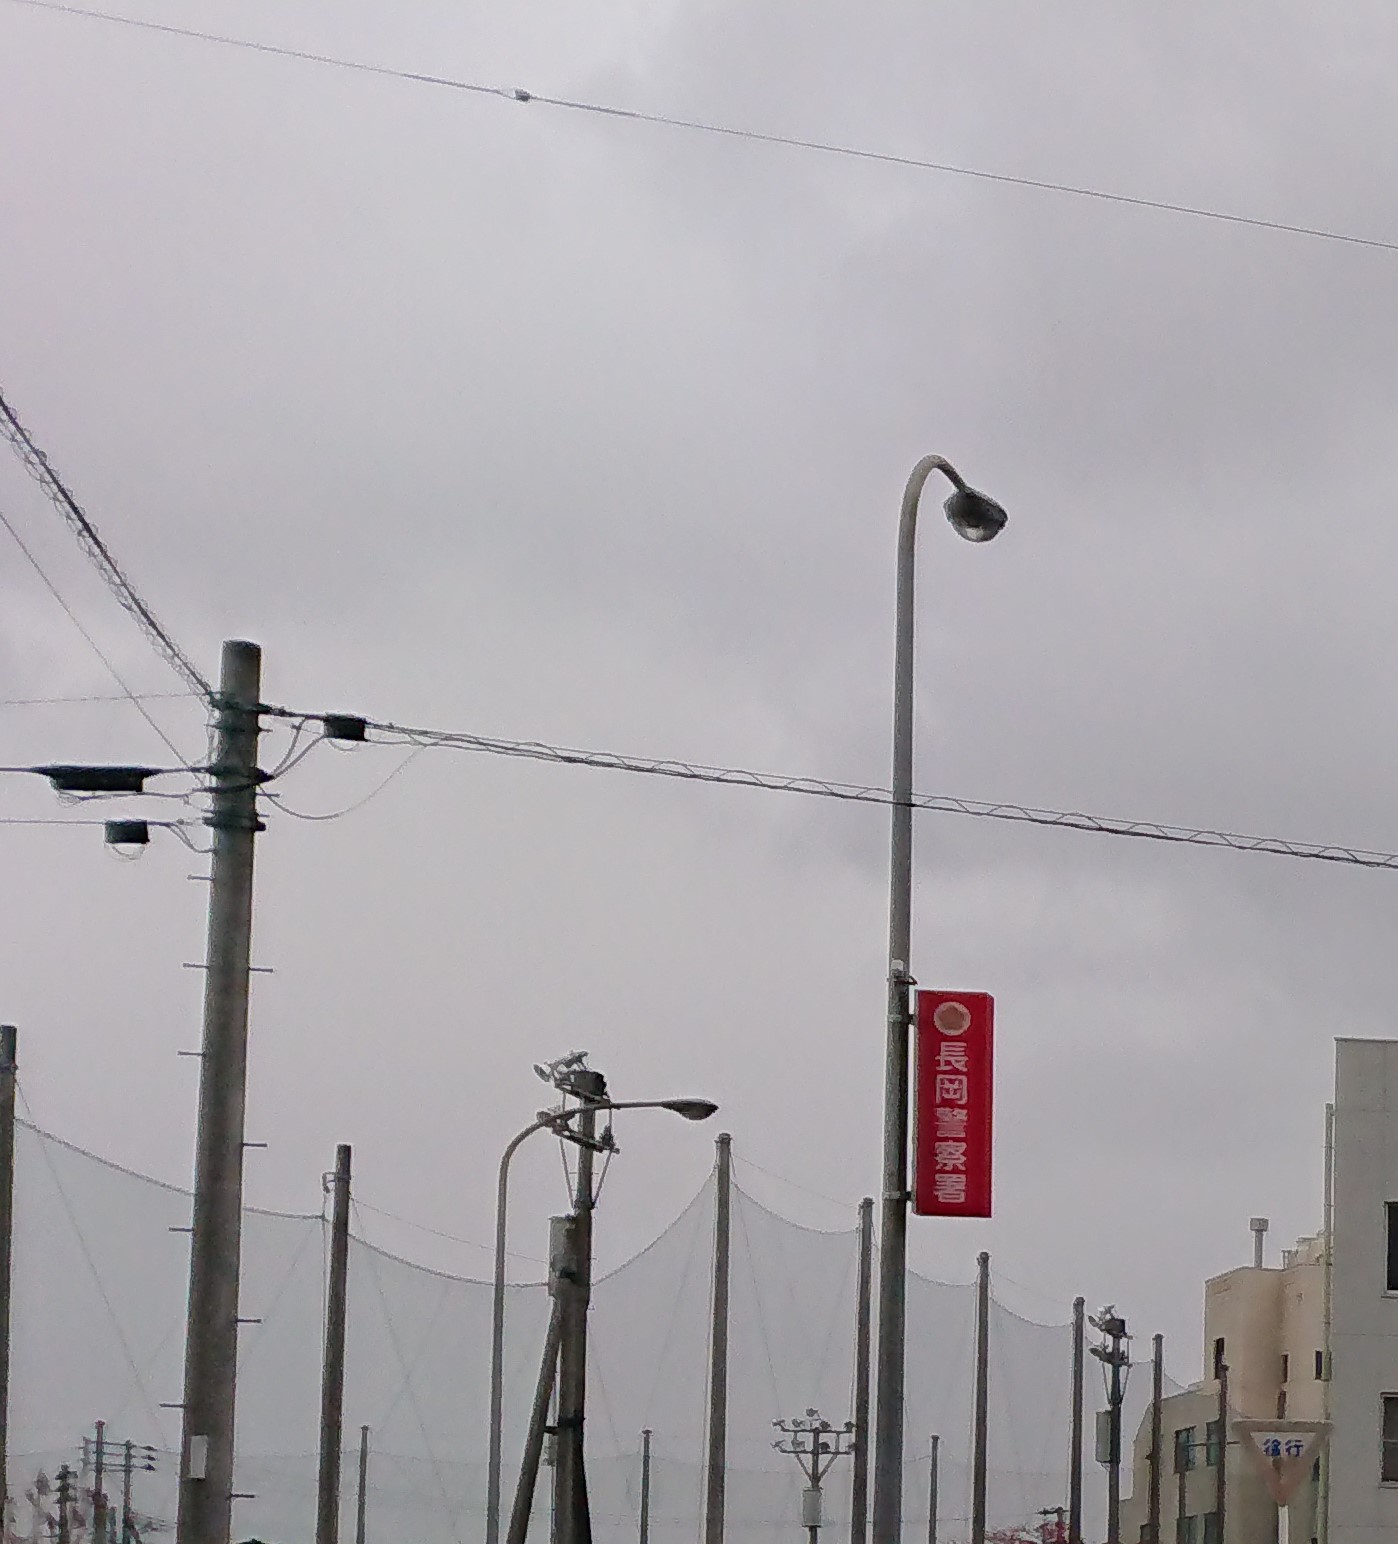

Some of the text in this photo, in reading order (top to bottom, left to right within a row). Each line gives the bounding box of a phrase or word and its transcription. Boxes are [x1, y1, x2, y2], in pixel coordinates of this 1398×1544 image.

[934, 1041, 969, 1204] 長岡警察署
[1263, 1438, 1304, 1457] 徐行
